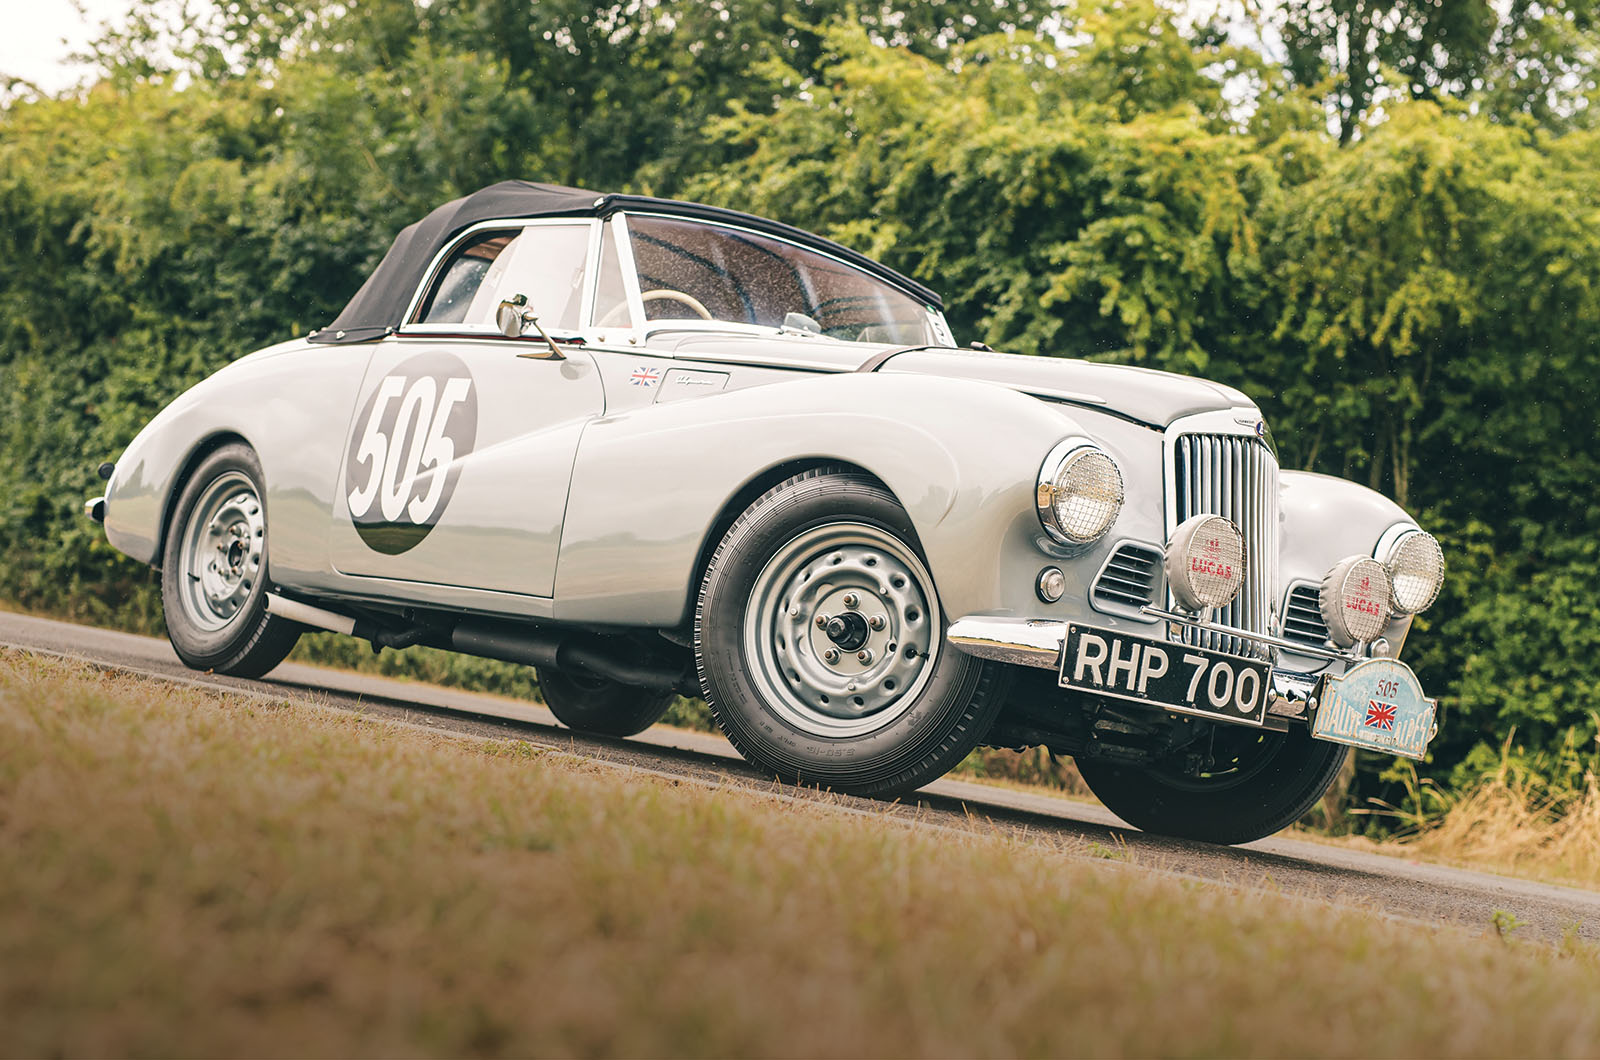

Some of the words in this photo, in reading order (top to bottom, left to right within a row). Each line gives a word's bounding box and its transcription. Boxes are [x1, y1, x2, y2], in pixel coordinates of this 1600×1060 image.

[348, 375, 472, 525] 505
[1191, 556, 1232, 580] LUCAS
[1346, 594, 1380, 617] LUCAS
[1073, 633, 1169, 693] RHP
[1182, 653, 1260, 714] 700
[1375, 679, 1399, 699] 505
